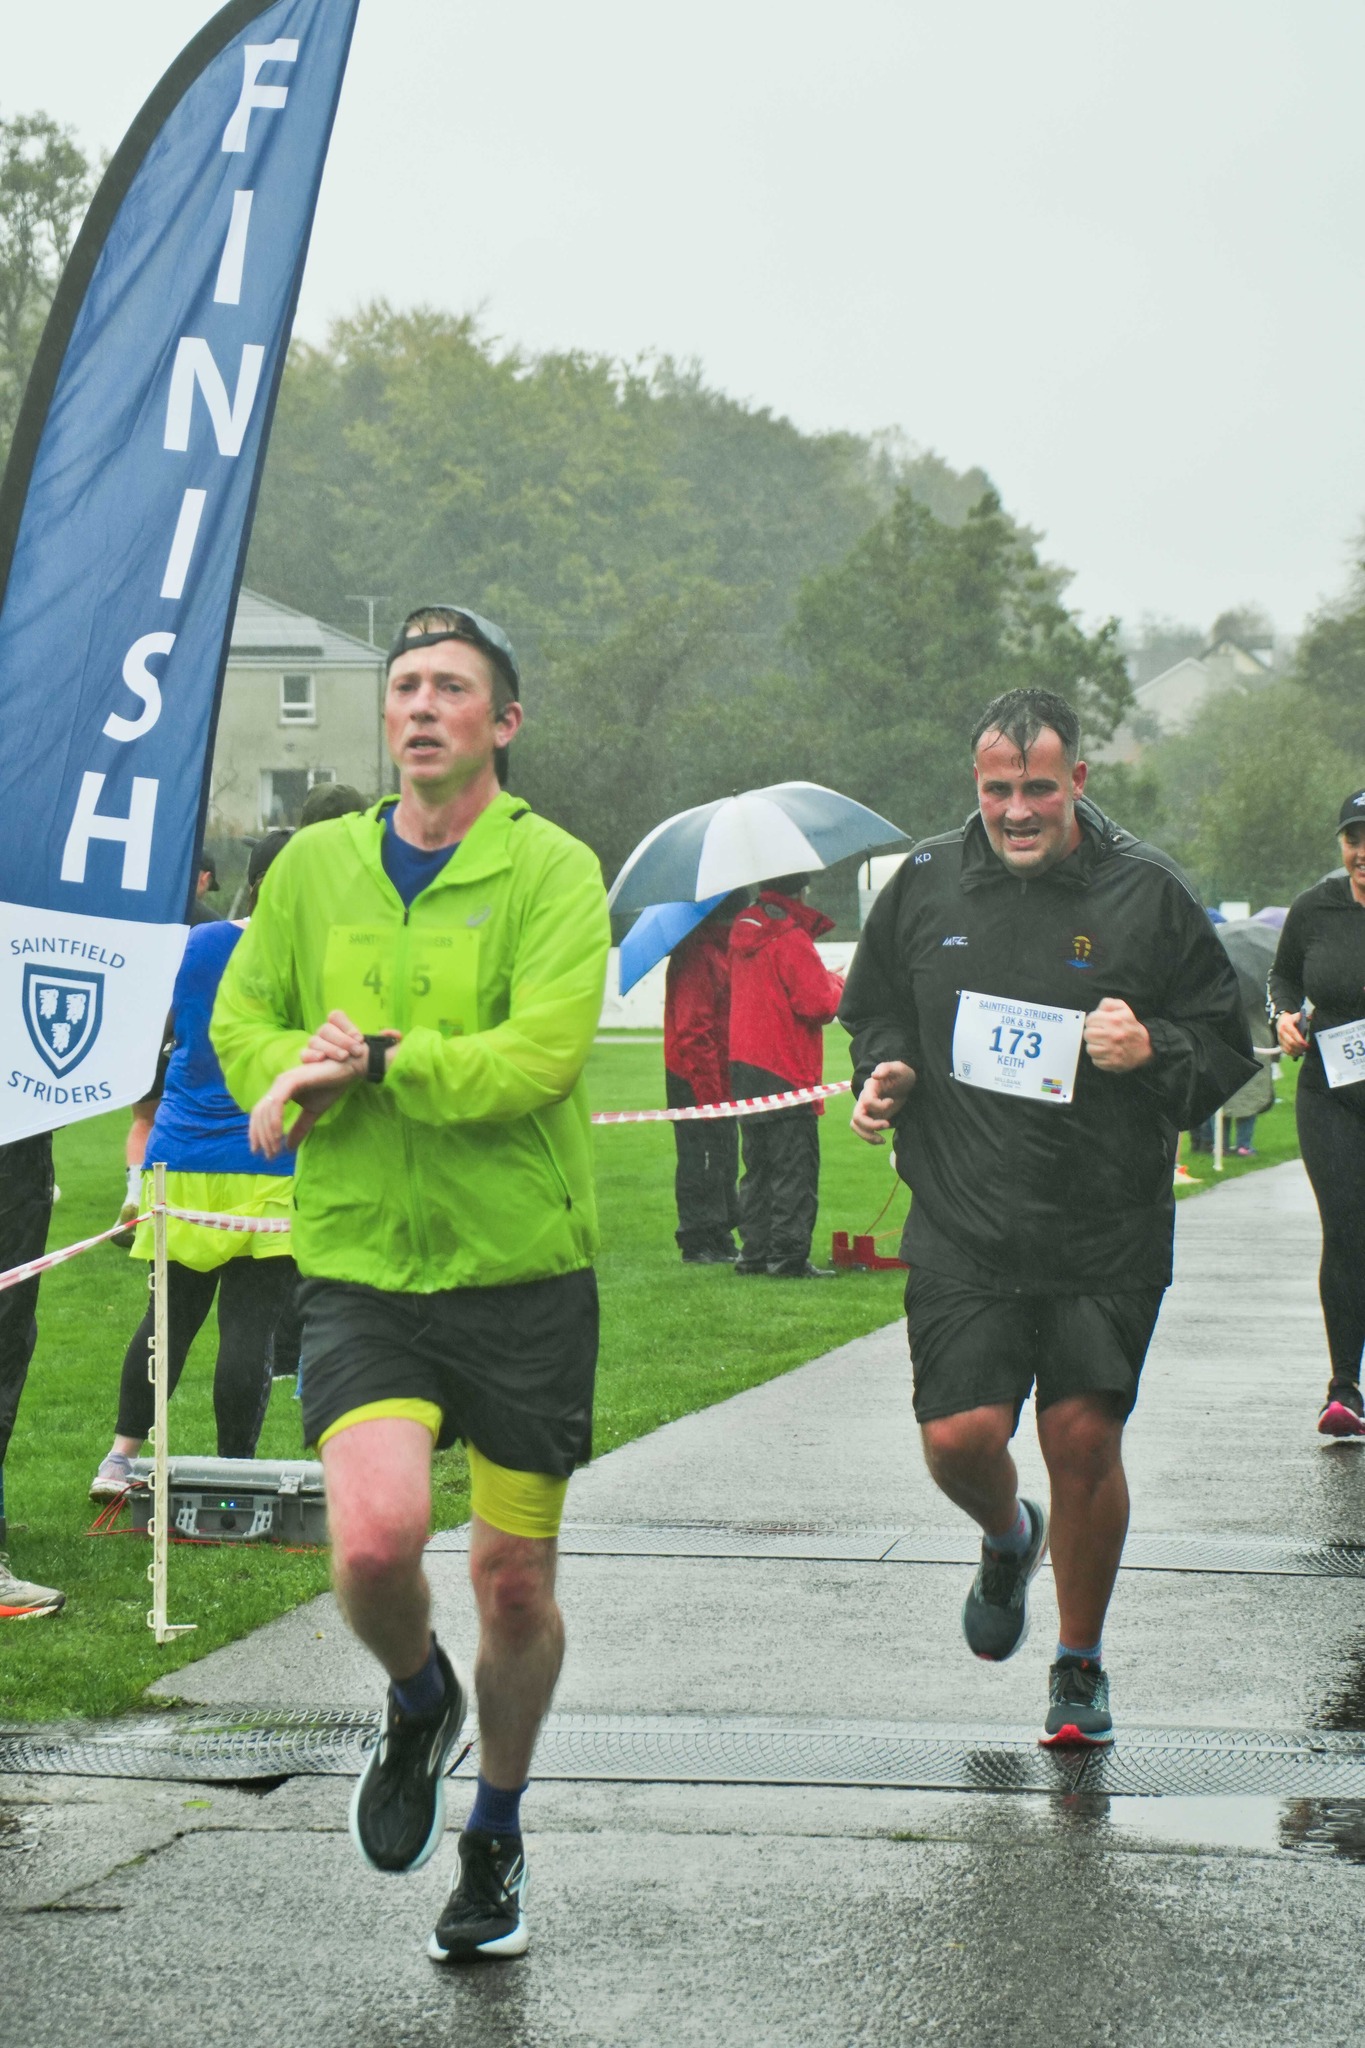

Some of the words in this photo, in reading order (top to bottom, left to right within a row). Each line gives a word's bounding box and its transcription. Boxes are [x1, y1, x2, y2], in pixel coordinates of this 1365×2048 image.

[60, 39, 299, 891] FINISH
[914, 852, 932, 864] KD
[10, 937, 126, 969] SAINTFIELD
[979, 999, 1022, 1015] SAINTFIELD
[1023, 1007, 1063, 1023] STRIDERS
[1001, 1015, 1016, 1026] 10K
[1018, 1018, 1024, 1028] &
[1026, 1019, 1037, 1029] 5K
[989, 1025, 1043, 1059] 173
[997, 1055, 1025, 1068] KEITH
[7, 1070, 112, 1104] STRIDERS
